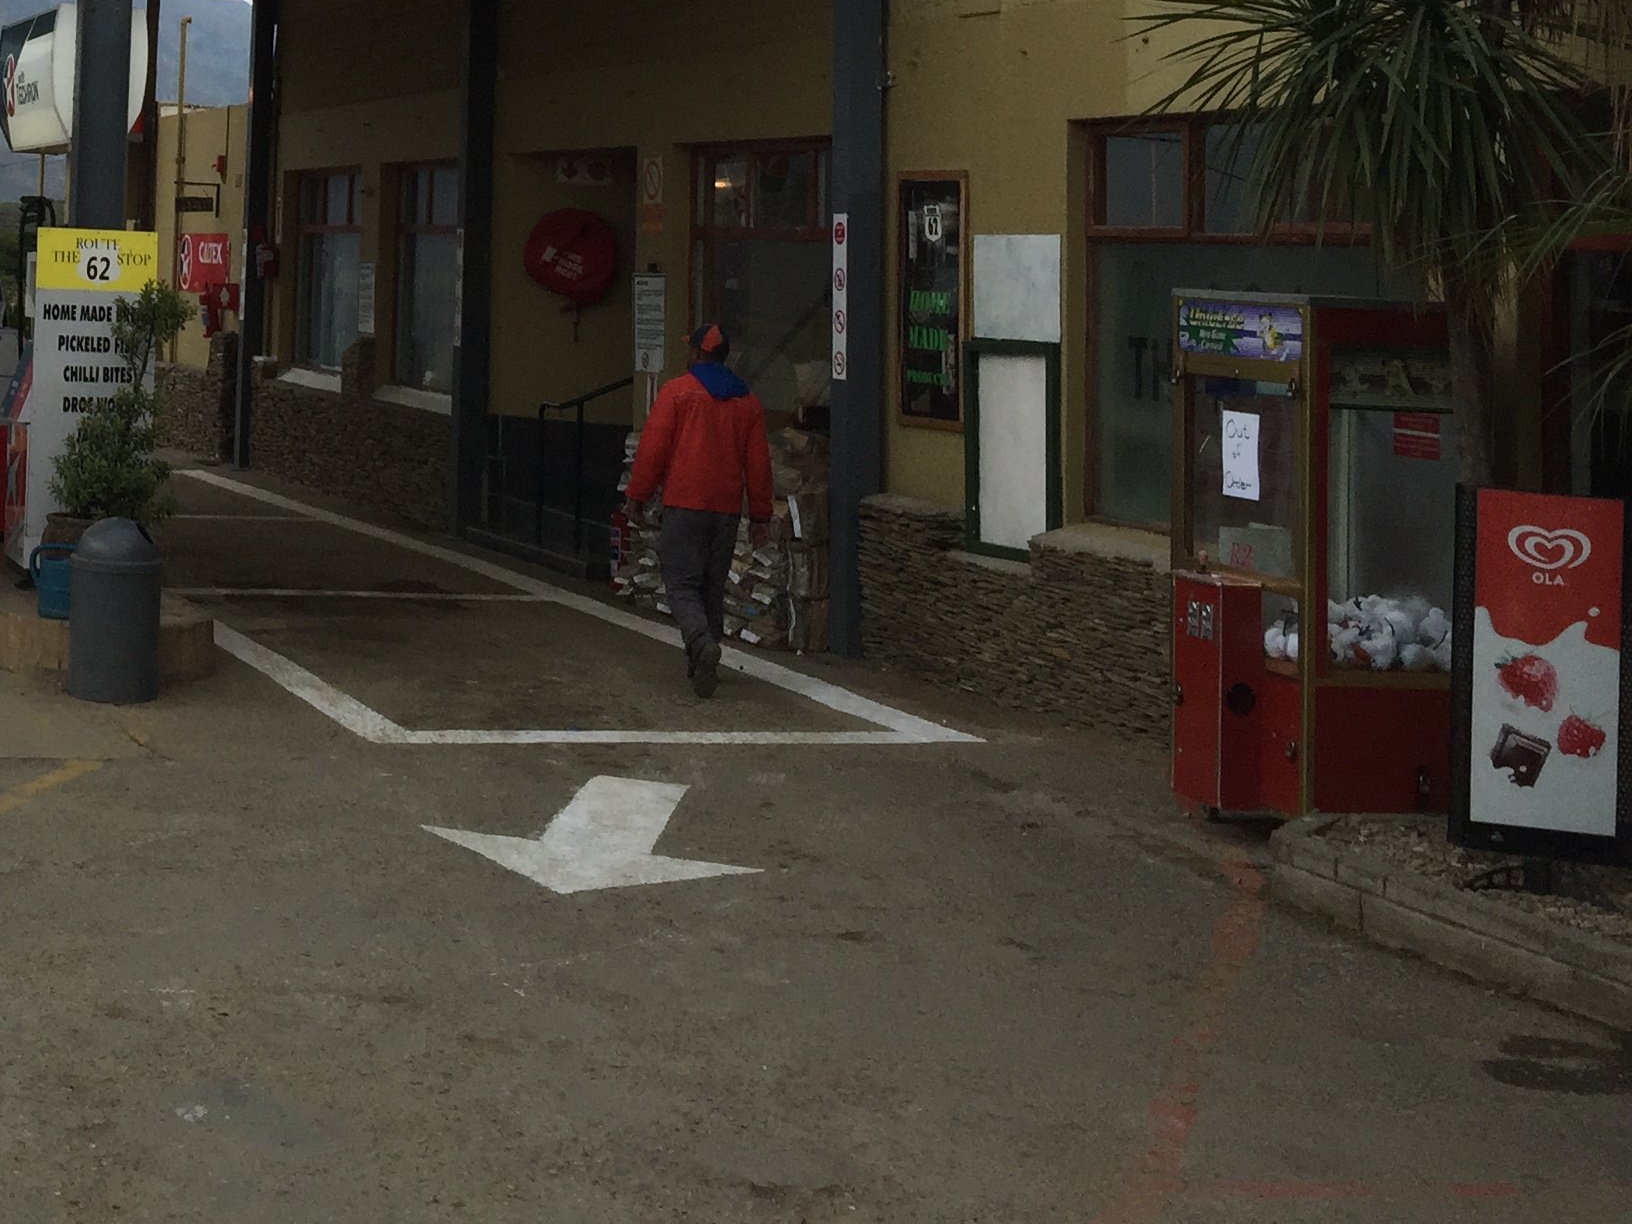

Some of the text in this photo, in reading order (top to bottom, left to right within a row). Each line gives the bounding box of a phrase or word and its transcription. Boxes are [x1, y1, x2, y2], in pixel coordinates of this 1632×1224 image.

[53, 250, 151, 266] THE STOP
[86, 256, 110, 281] 62
[43, 303, 77, 321] HOME
[80, 305, 113, 322] MADE
[57, 335, 110, 353] PICKELED
[63, 365, 132, 384] CHILLI BITES
[1225, 418, 1250, 440] Out
[1532, 571, 1565, 586] OLA
